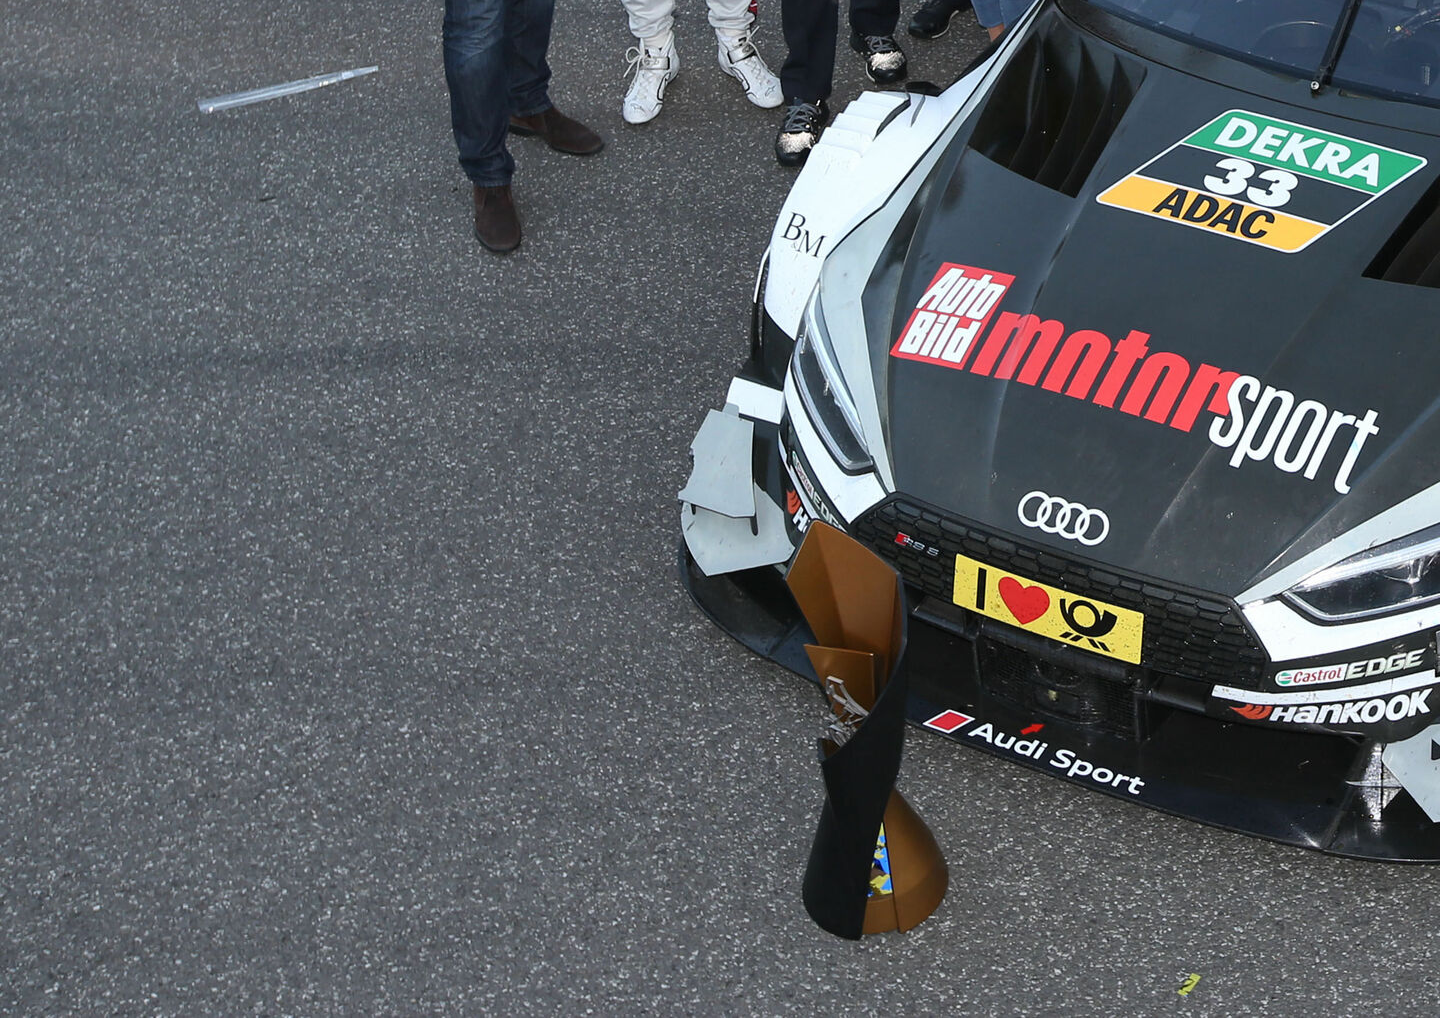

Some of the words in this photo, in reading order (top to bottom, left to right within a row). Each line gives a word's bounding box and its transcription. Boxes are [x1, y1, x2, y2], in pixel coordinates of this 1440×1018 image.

[1213, 117, 1380, 188] DEKRA
[1202, 158, 1299, 208] 33
[1151, 188, 1276, 239] ADAC
[916, 268, 1007, 317] Auto
[898, 310, 982, 365] Bild
[968, 310, 1381, 495] motorsport
[975, 566, 987, 611] I
[1293, 666, 1341, 684] Castrol
[1345, 647, 1427, 680] EDGE
[967, 723, 1048, 760] Audi
[1050, 749, 1145, 795] Sport
